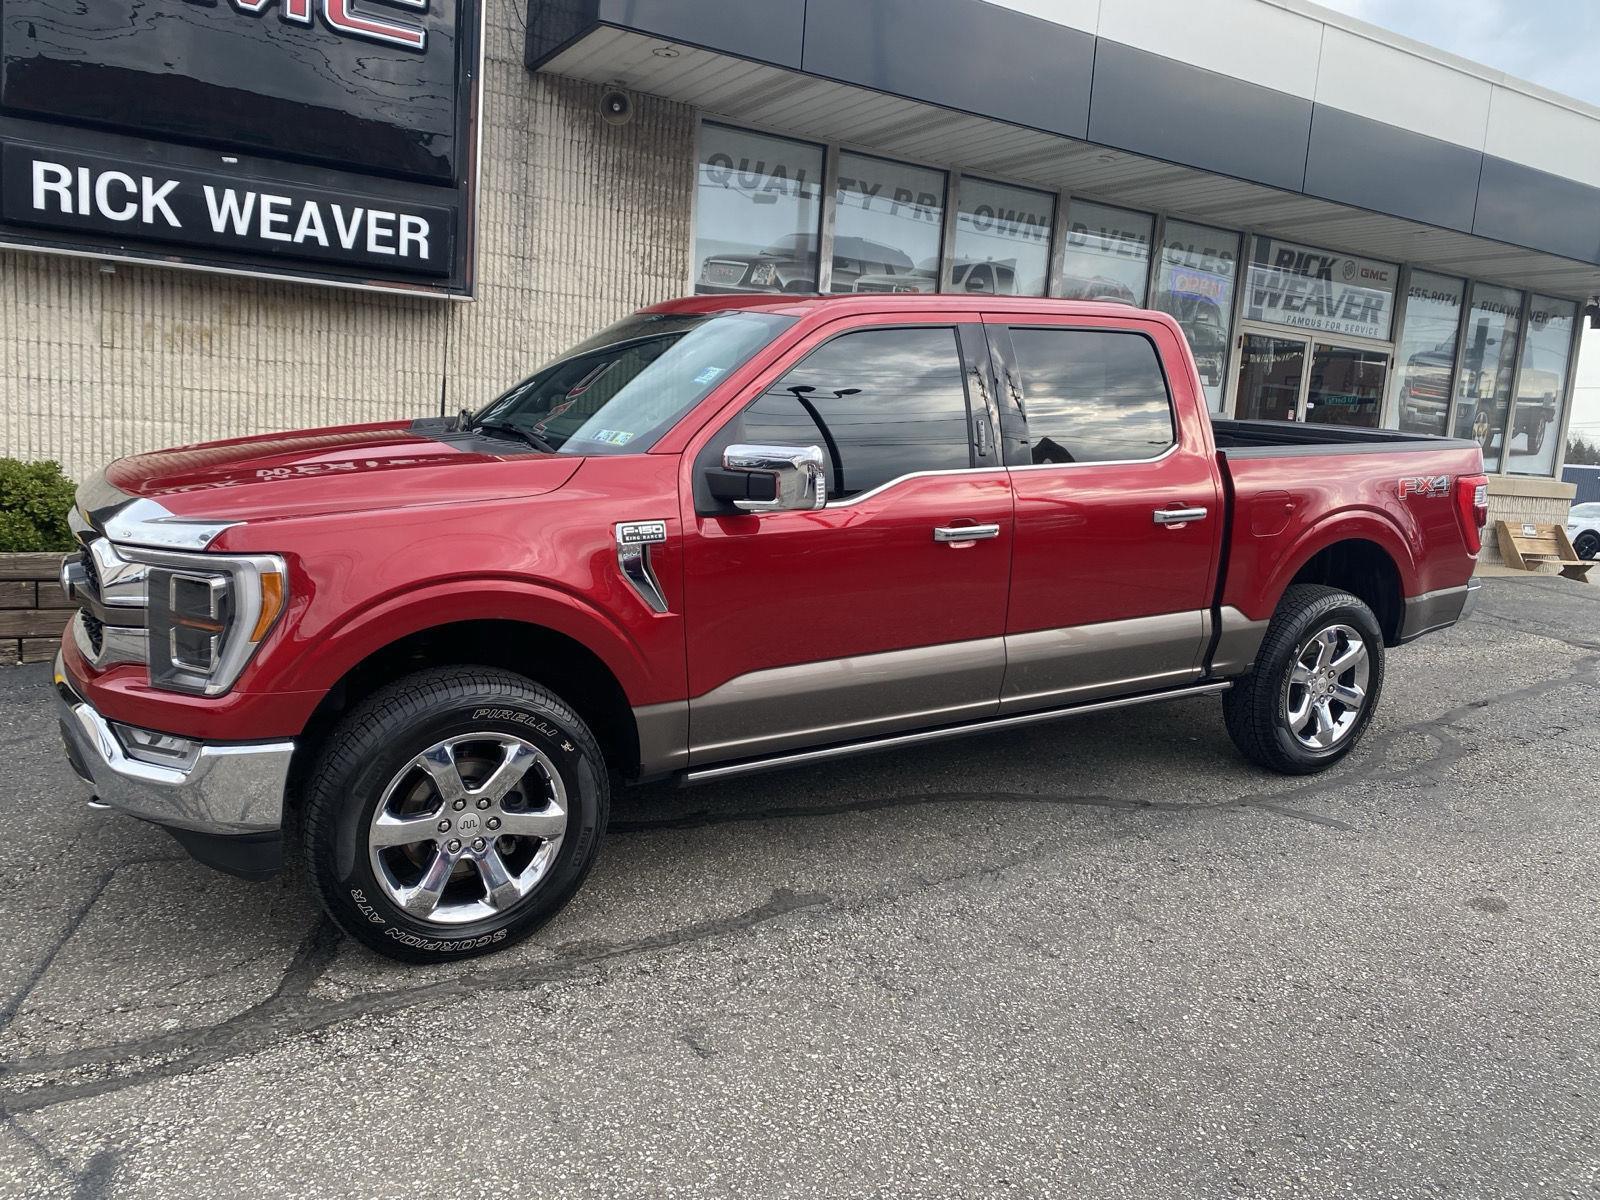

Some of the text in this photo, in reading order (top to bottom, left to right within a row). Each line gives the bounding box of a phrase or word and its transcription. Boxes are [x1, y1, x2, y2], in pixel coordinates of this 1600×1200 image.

[705, 152, 883, 210] QUALTY
[32, 160, 430, 260] RICK WEAVER
[1274, 248, 1339, 281] RICK
[1360, 267, 1389, 281] GMC
[1252, 270, 1386, 324] WEAVER
[1286, 315, 1379, 336] FAMOUS FOR SERVICE
[1398, 475, 1449, 500] FX4
[623, 525, 663, 535] F-150
[472, 708, 558, 737] PIRELLI
[351, 889, 507, 952] SCORPION ATR
